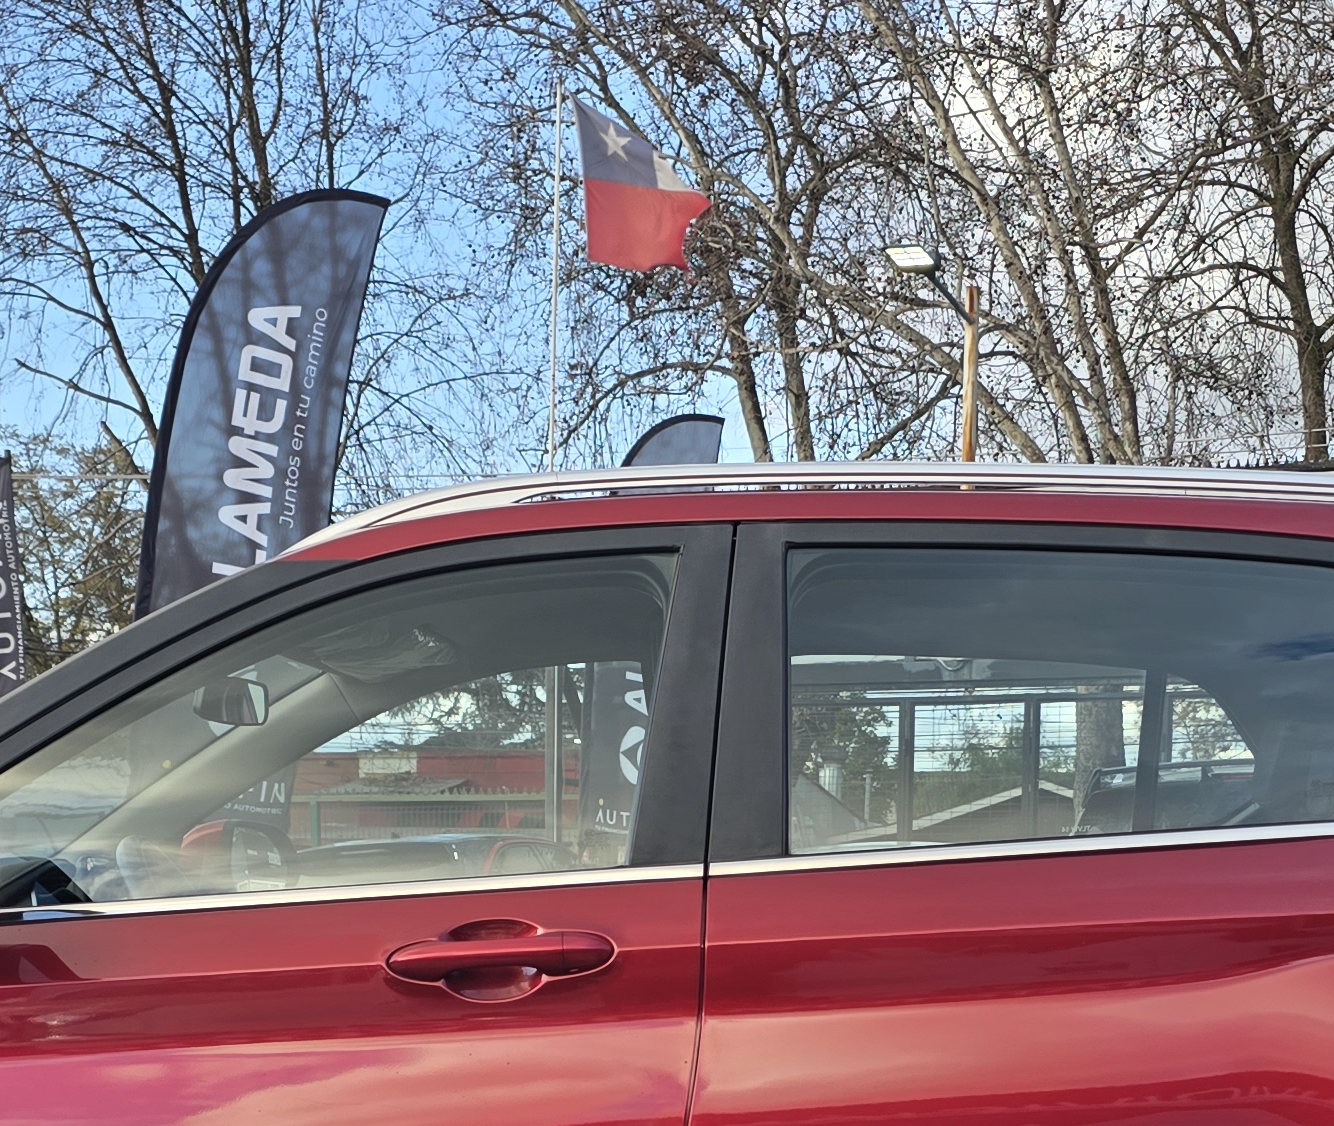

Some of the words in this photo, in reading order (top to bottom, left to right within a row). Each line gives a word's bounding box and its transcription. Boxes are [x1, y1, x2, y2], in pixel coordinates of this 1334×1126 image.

[303, 307, 328, 389] camino
[211, 304, 302, 577] LAMEDA
[291, 422, 306, 450] en
[295, 393, 311, 418] tu
[279, 455, 301, 529] Juntos
